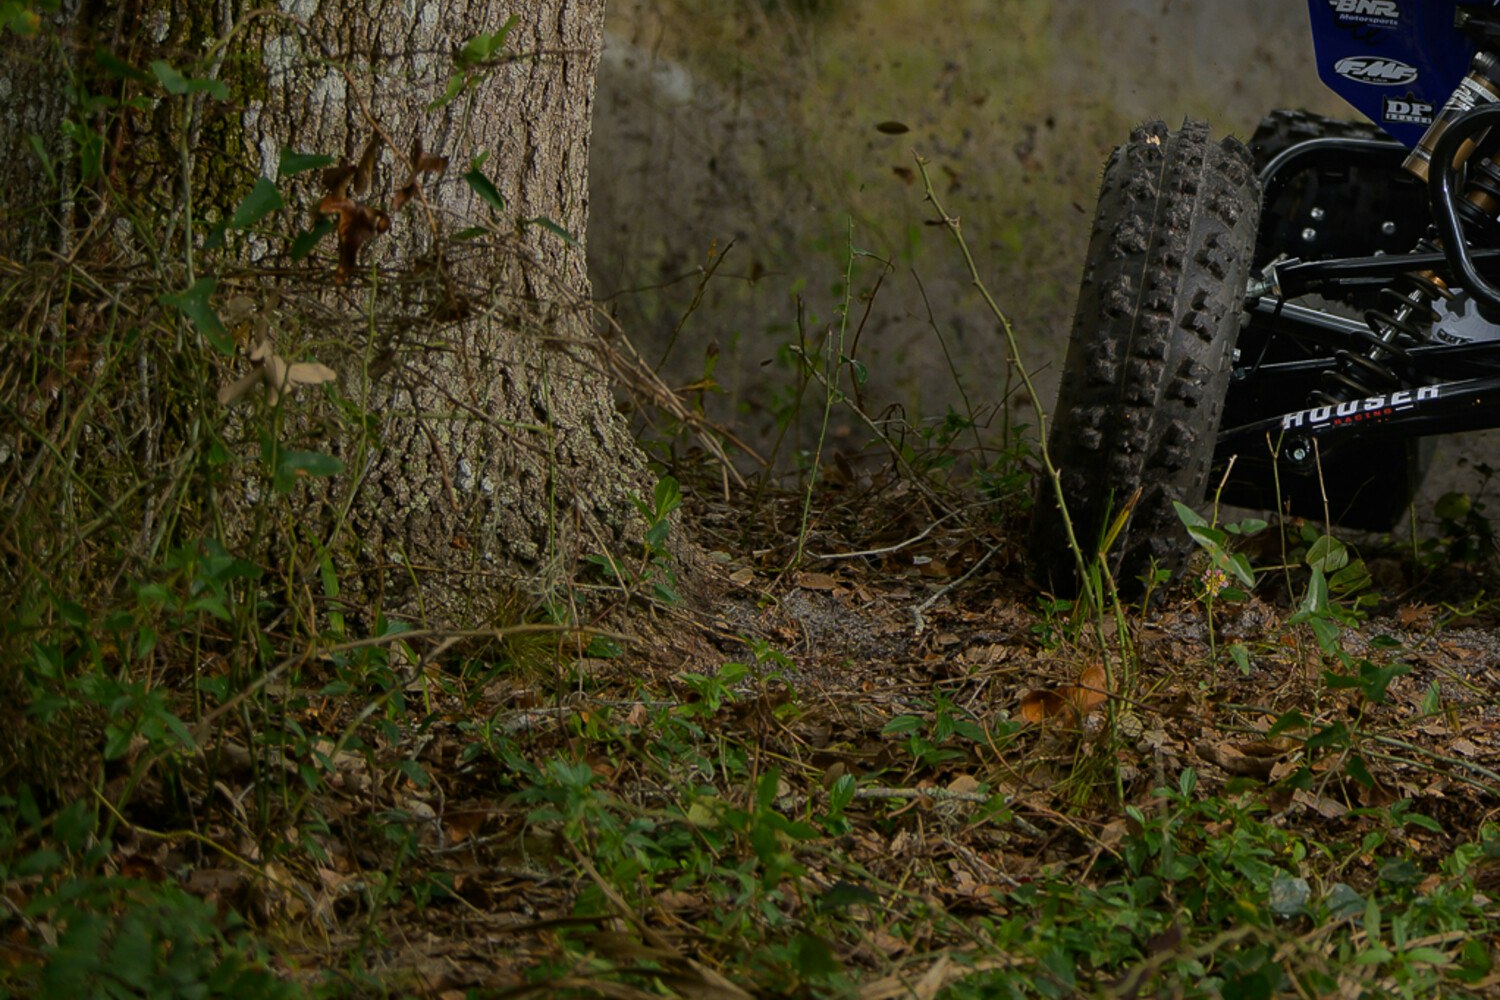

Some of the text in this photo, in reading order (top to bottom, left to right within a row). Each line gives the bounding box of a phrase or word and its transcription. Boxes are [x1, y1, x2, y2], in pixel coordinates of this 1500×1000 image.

[1339, 13, 1399, 26] Motorsports
[1334, 59, 1418, 80] FMF
[1386, 100, 1433, 116] DP
[1282, 384, 1440, 430] HOUSER
[1333, 407, 1393, 425] RACING
